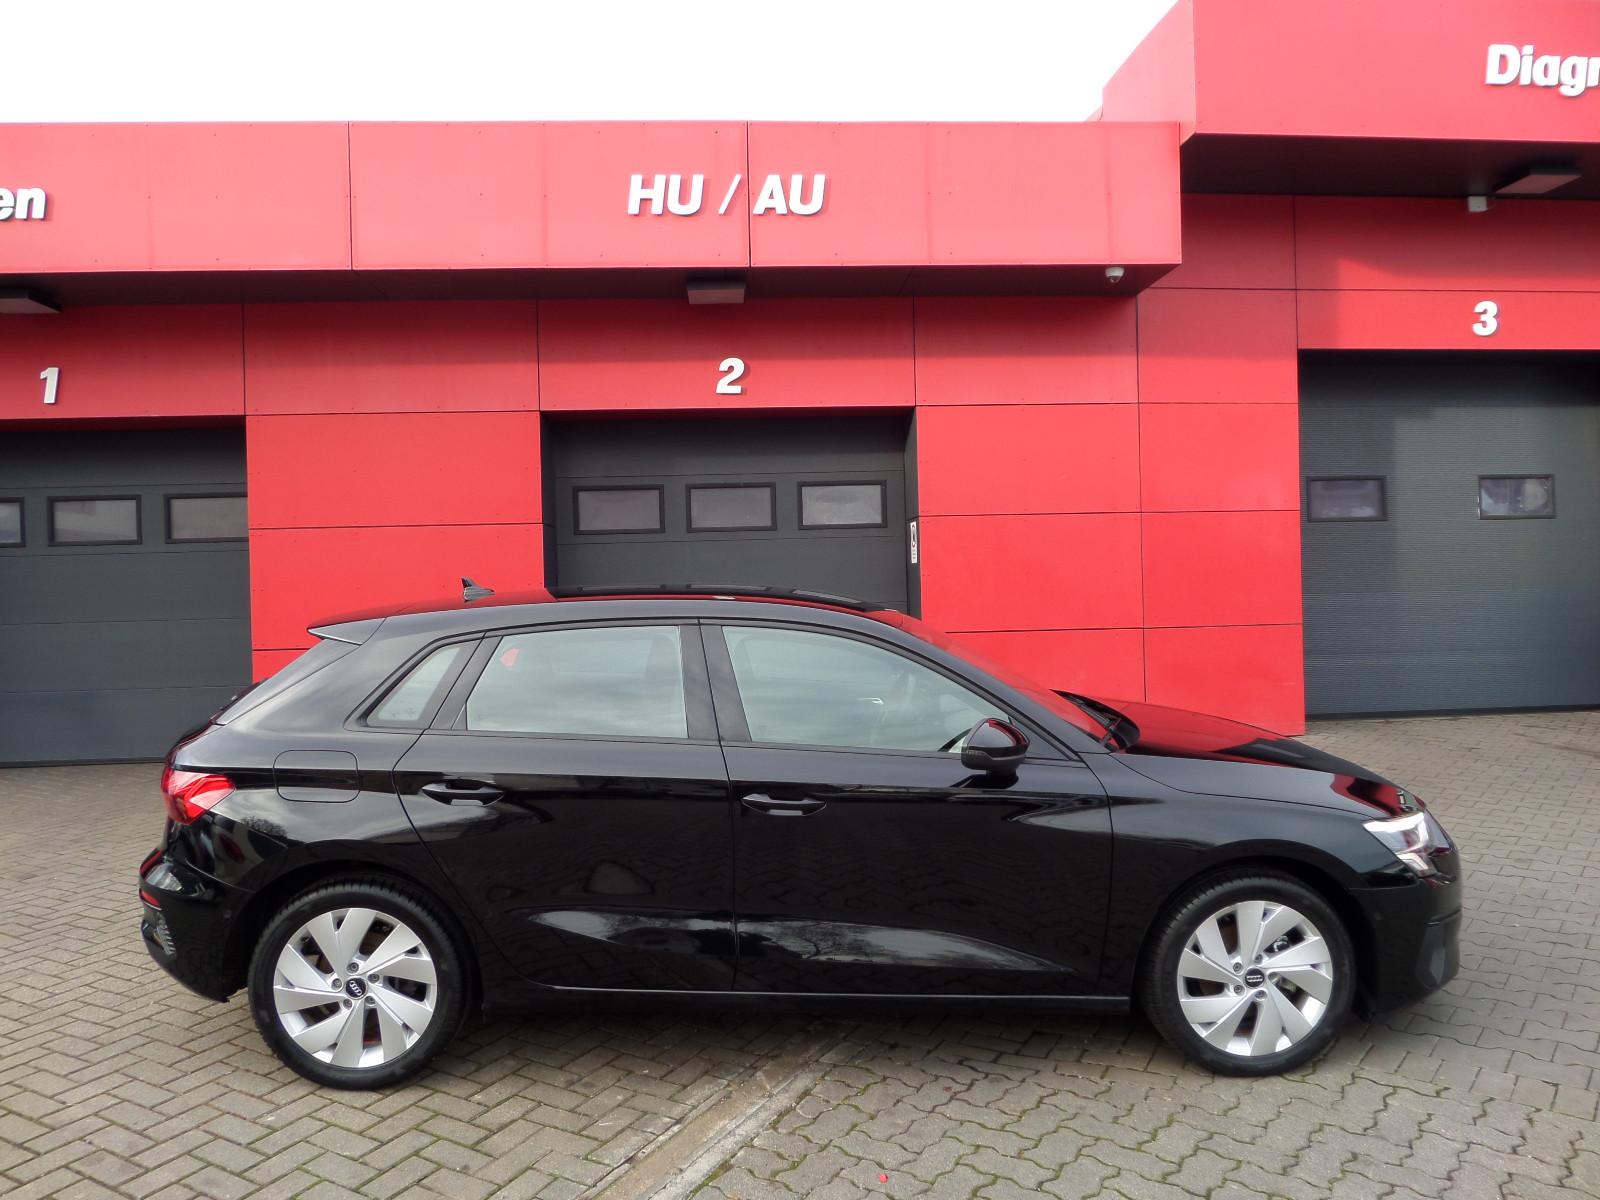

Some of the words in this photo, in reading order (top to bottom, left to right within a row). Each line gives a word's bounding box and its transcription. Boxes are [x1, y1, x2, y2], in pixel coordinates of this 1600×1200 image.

[627, 173, 704, 216] HU
[752, 173, 826, 216] AU
[1472, 300, 1498, 336] 3
[39, 367, 60, 404] 1
[715, 357, 745, 394] 2
